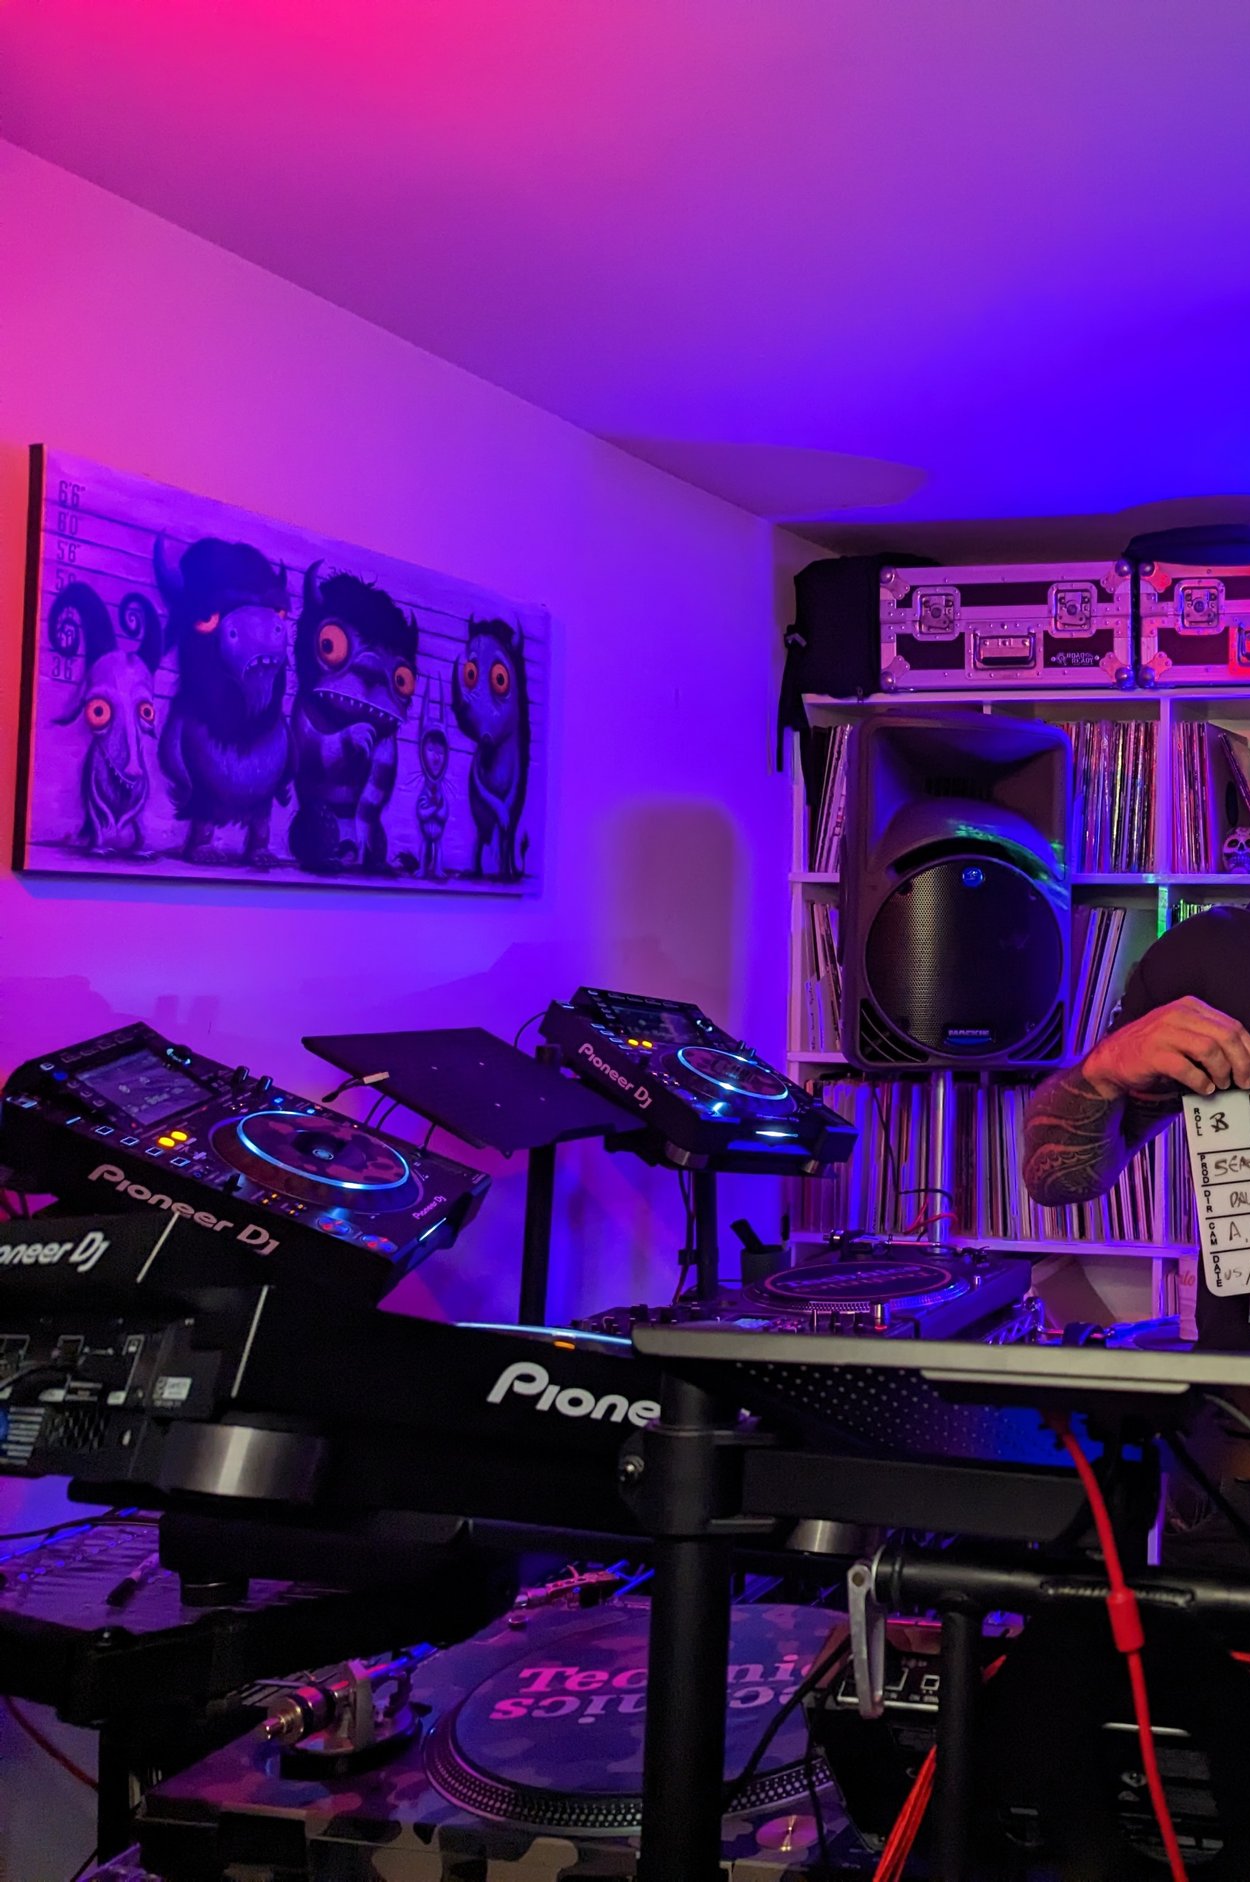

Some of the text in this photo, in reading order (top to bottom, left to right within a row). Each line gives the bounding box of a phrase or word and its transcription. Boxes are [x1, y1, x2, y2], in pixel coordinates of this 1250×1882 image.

[578, 1043, 653, 1109] Pioneer DJ
[1194, 1108, 1202, 1136] ROLL
[1200, 1155, 1210, 1184] PROD
[87, 1163, 280, 1256] Pioneer DJ
[1204, 1190, 1213, 1213] DIR
[1209, 1222, 1218, 1246] CAM
[0, 1230, 110, 1273] oneer DJ
[1212, 1256, 1223, 1287] DATE
[486, 1361, 661, 1427] Pione
